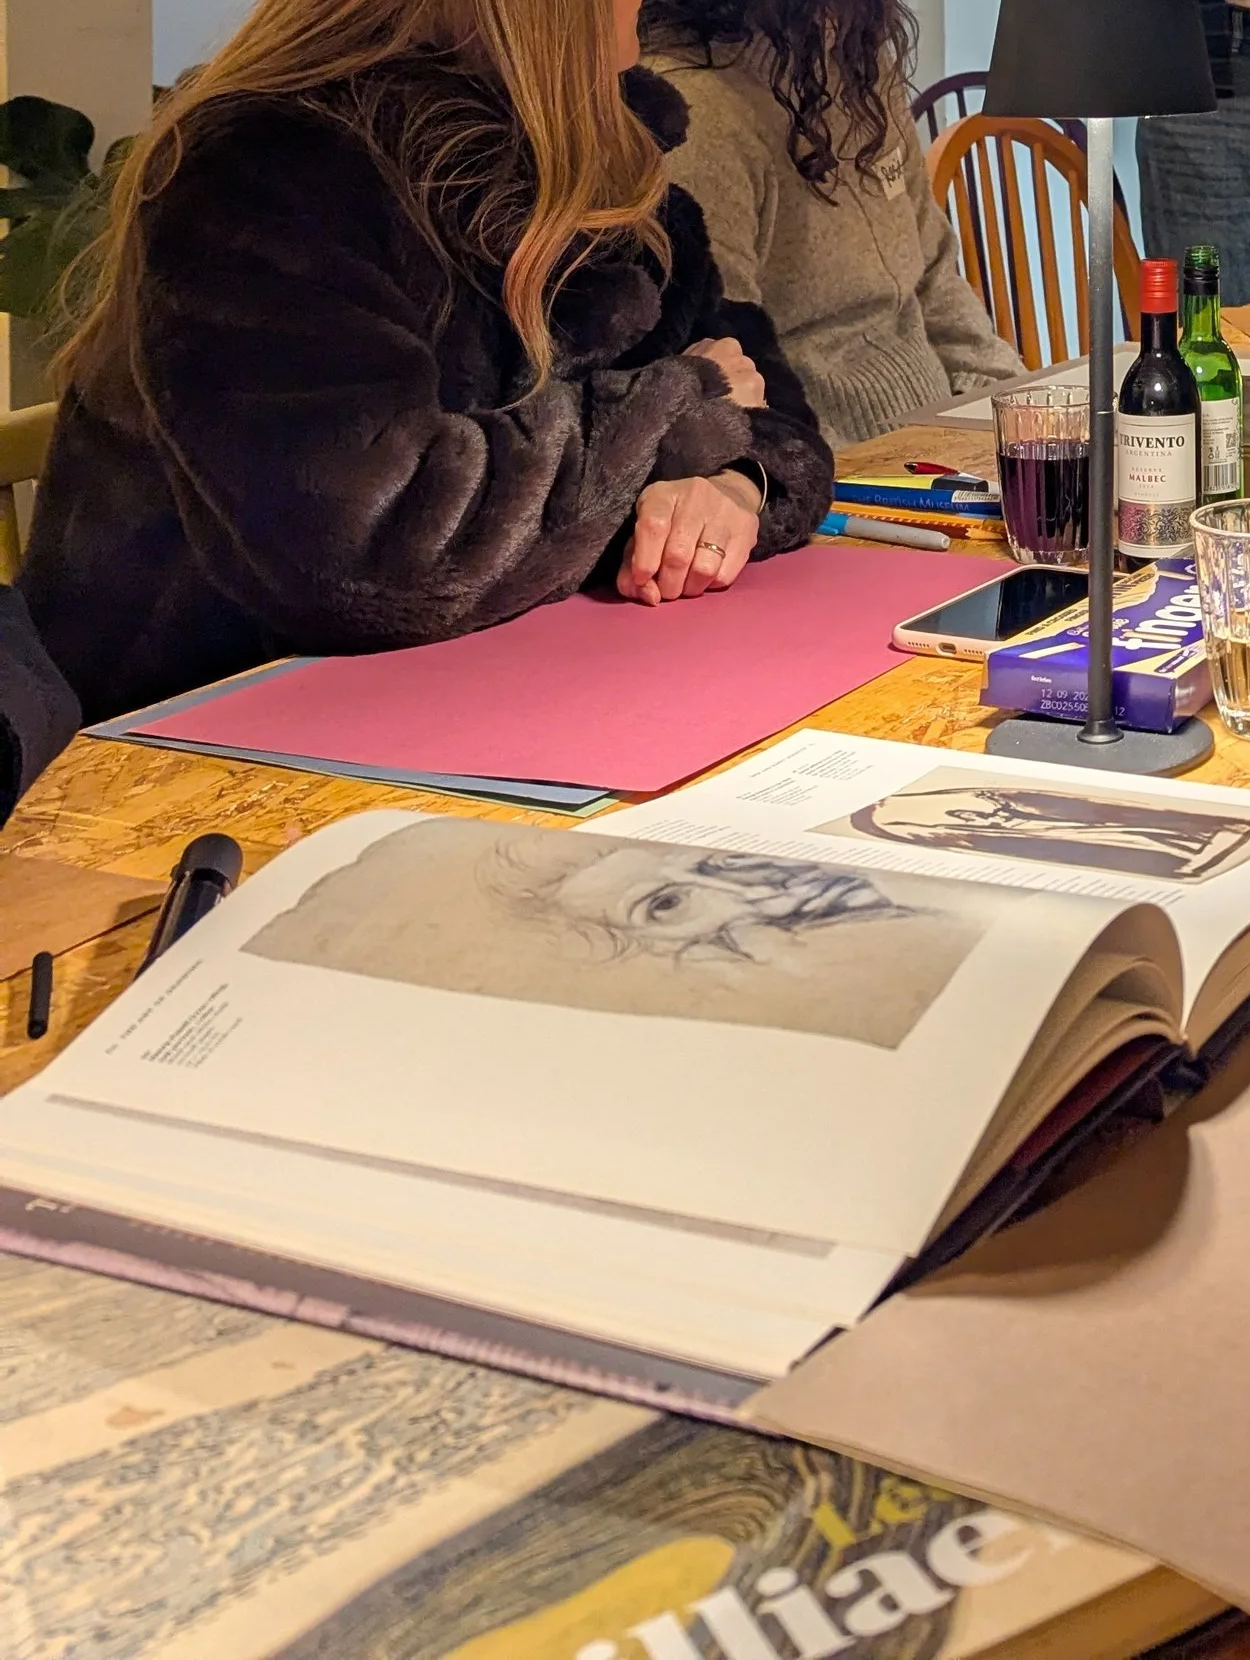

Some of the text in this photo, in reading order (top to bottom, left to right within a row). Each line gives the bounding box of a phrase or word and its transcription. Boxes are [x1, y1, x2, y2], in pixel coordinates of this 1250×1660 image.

[1120, 433, 1185, 449] TRIVENTO
[1125, 448, 1173, 457] ARGENTINA
[1128, 472, 1166, 483] MALBEC
[1041, 688, 1052, 698] 12
[1056, 690, 1068, 699] 09
